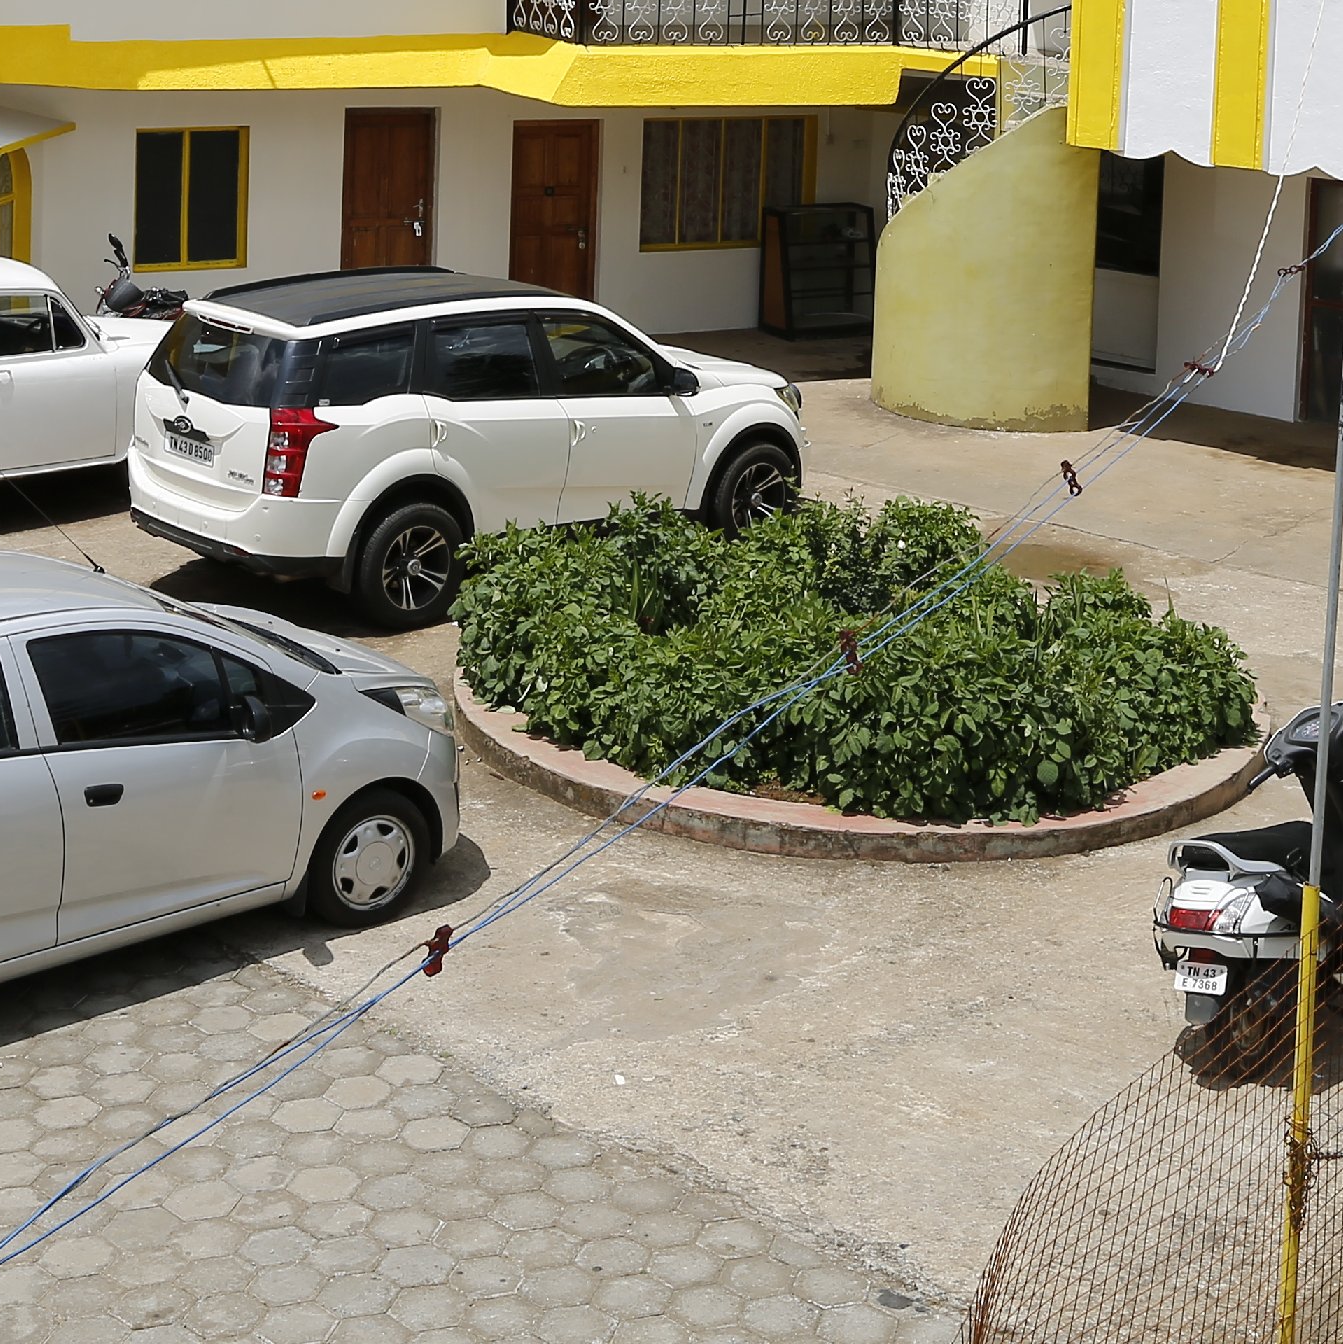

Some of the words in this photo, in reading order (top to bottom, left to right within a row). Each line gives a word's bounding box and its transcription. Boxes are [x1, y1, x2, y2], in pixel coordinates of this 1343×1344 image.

[1187, 965, 1200, 977] TN
[1202, 968, 1217, 978] 43
[1181, 977, 1188, 987] E
[1192, 977, 1218, 991] 7368
